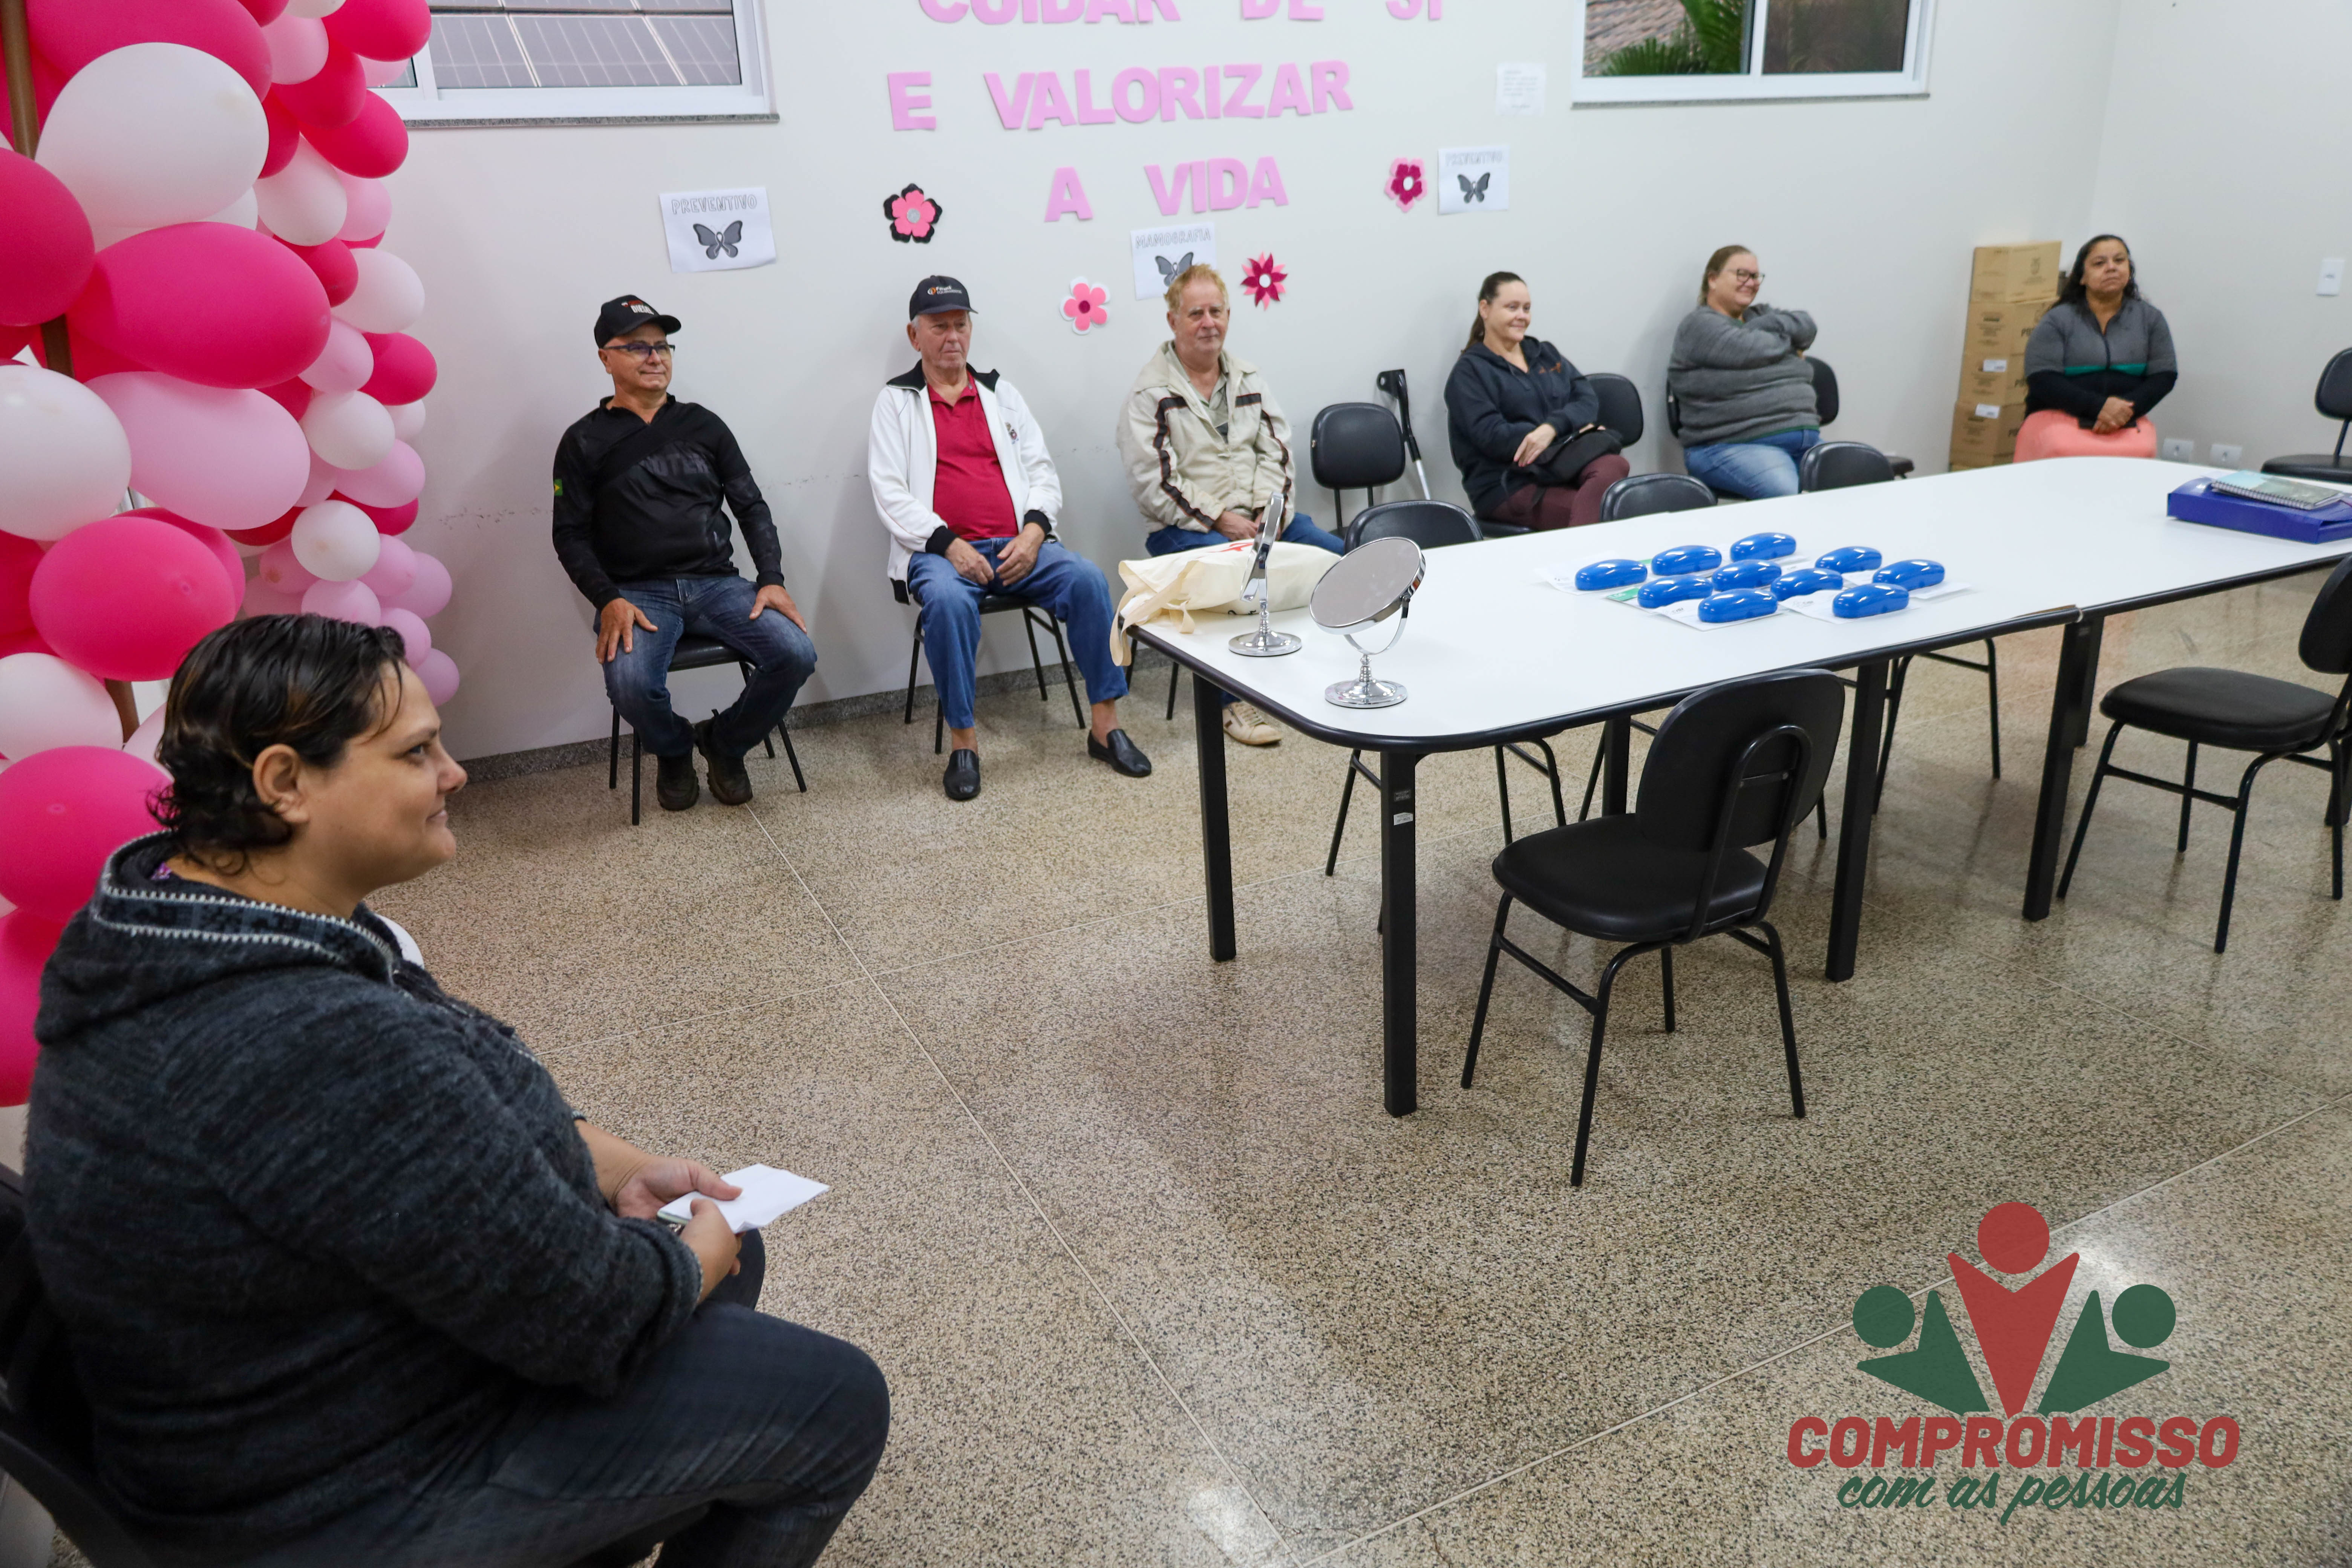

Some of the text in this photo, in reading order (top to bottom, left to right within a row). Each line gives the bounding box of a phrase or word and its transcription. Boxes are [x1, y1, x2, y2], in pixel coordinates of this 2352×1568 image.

[888, 60, 1353, 130] E VALORIZAR
[671, 194, 757, 214] PREVENTIVO
[1045, 156, 1288, 222] A VIDA
[1135, 228, 1211, 249] MAMOGRAFIA
